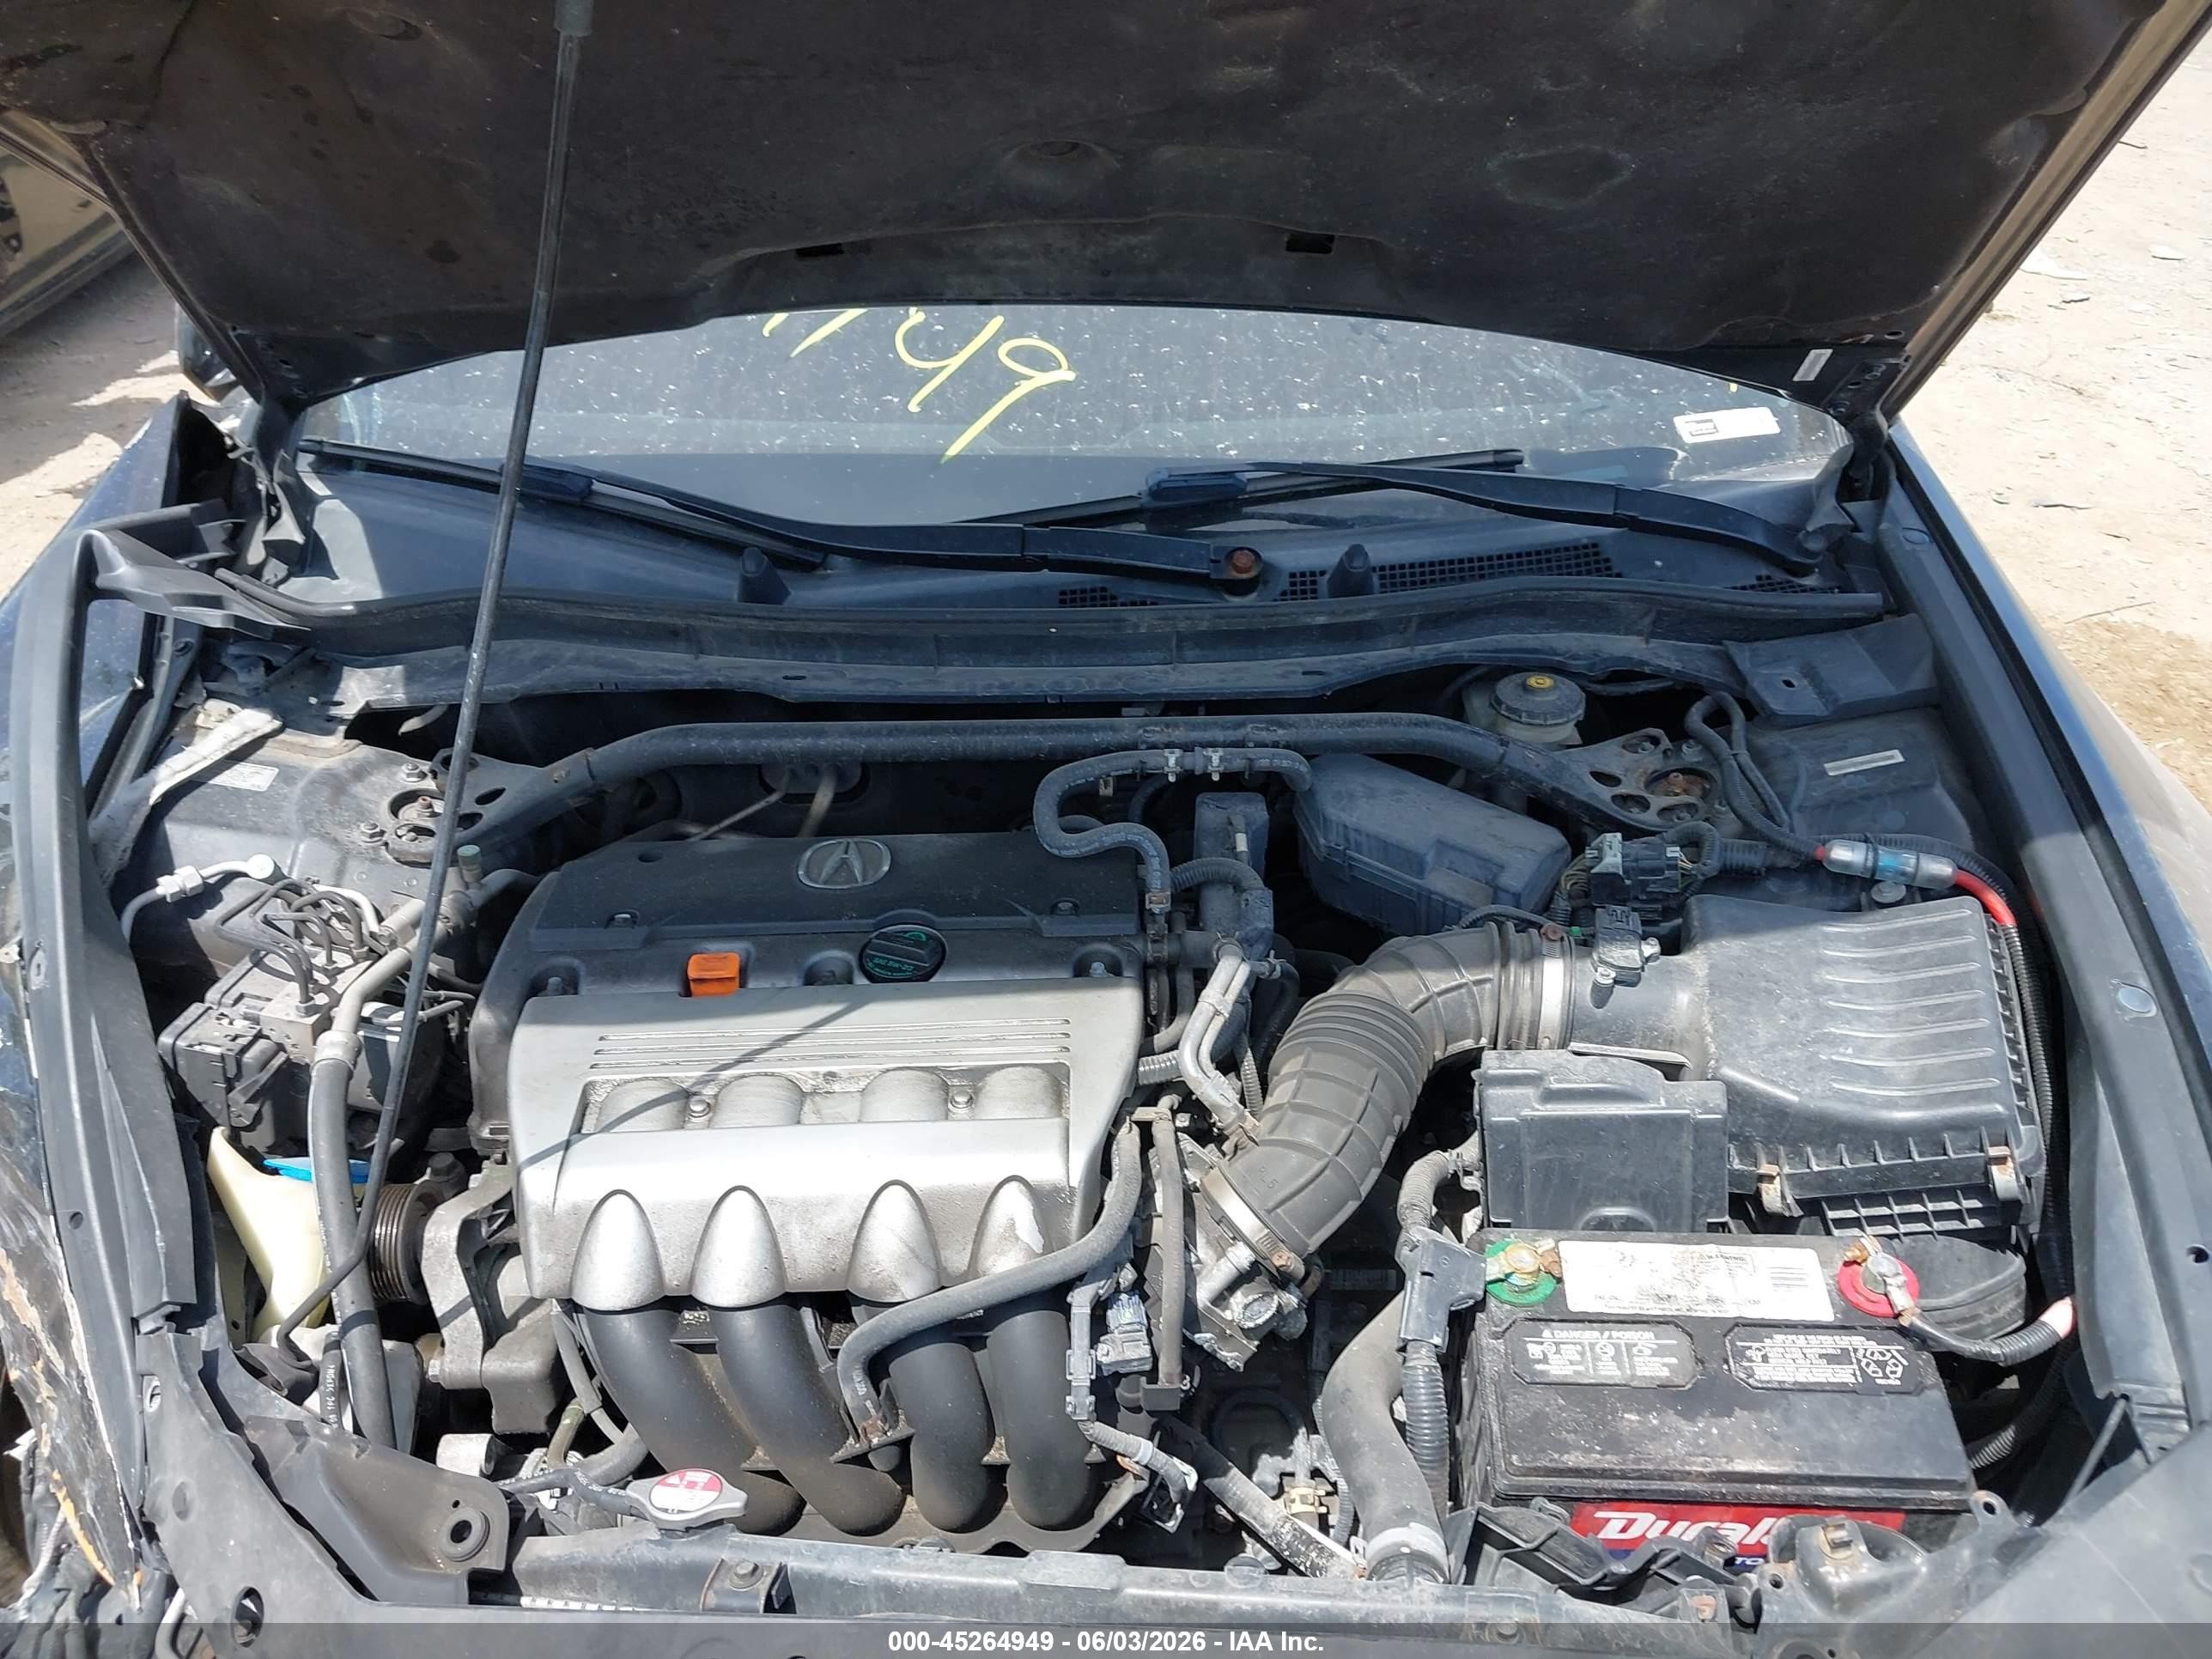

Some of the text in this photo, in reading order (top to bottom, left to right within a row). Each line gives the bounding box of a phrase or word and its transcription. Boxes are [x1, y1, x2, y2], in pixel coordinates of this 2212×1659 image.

[763, 307, 1077, 464] 49
[1553, 1329, 1601, 1340] DANGER
[1611, 1330, 1656, 1340] POISON
